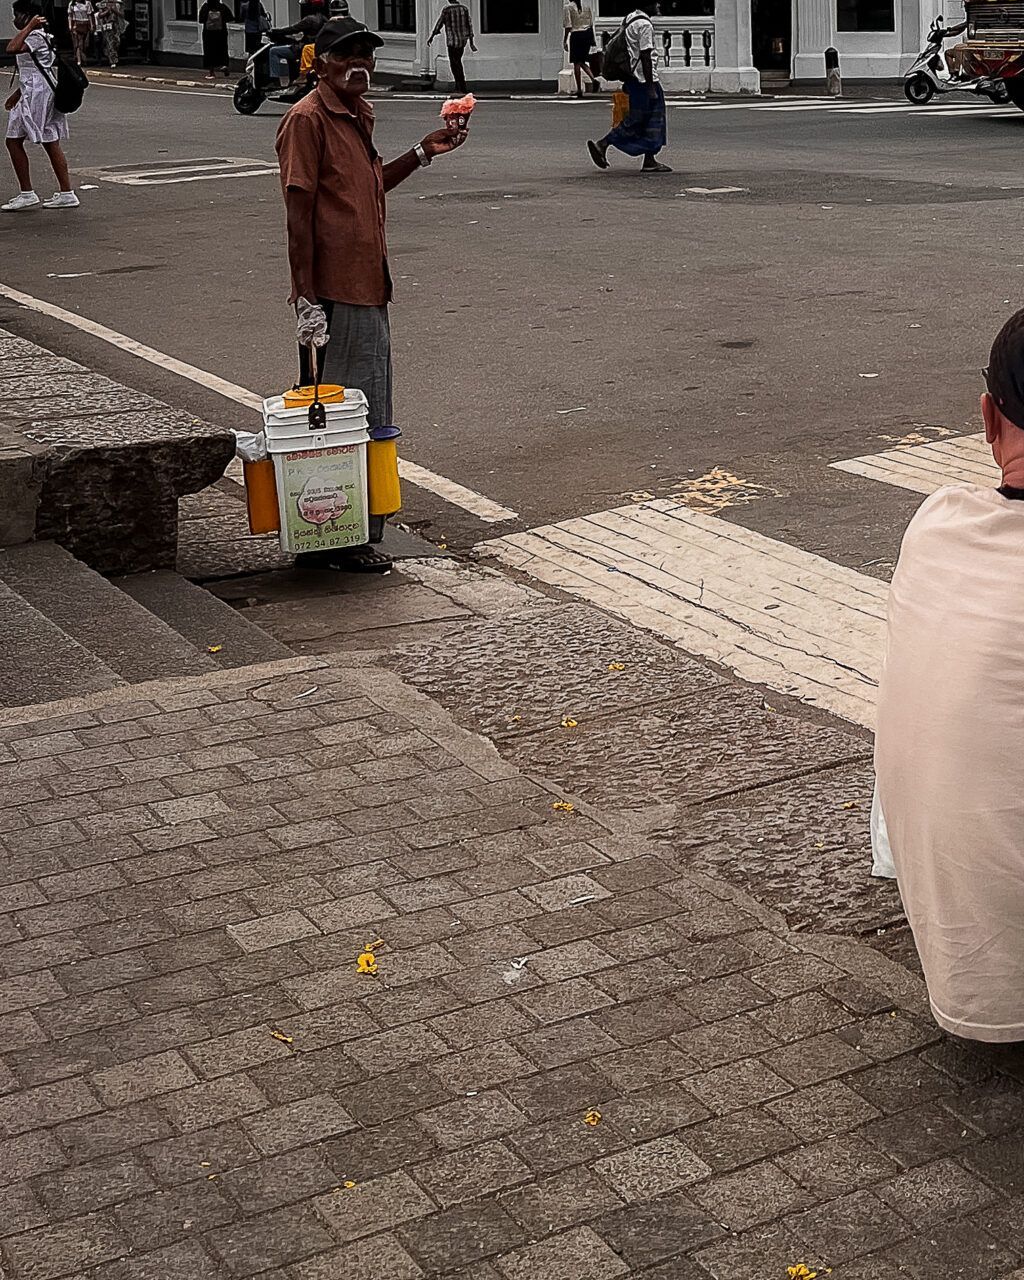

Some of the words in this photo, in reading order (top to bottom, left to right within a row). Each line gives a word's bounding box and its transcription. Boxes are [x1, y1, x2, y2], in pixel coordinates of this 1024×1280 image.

[294, 541, 311, 551] 072
[315, 539, 325, 548] 34
[329, 537, 340, 546] 87
[344, 534, 360, 544] 319
